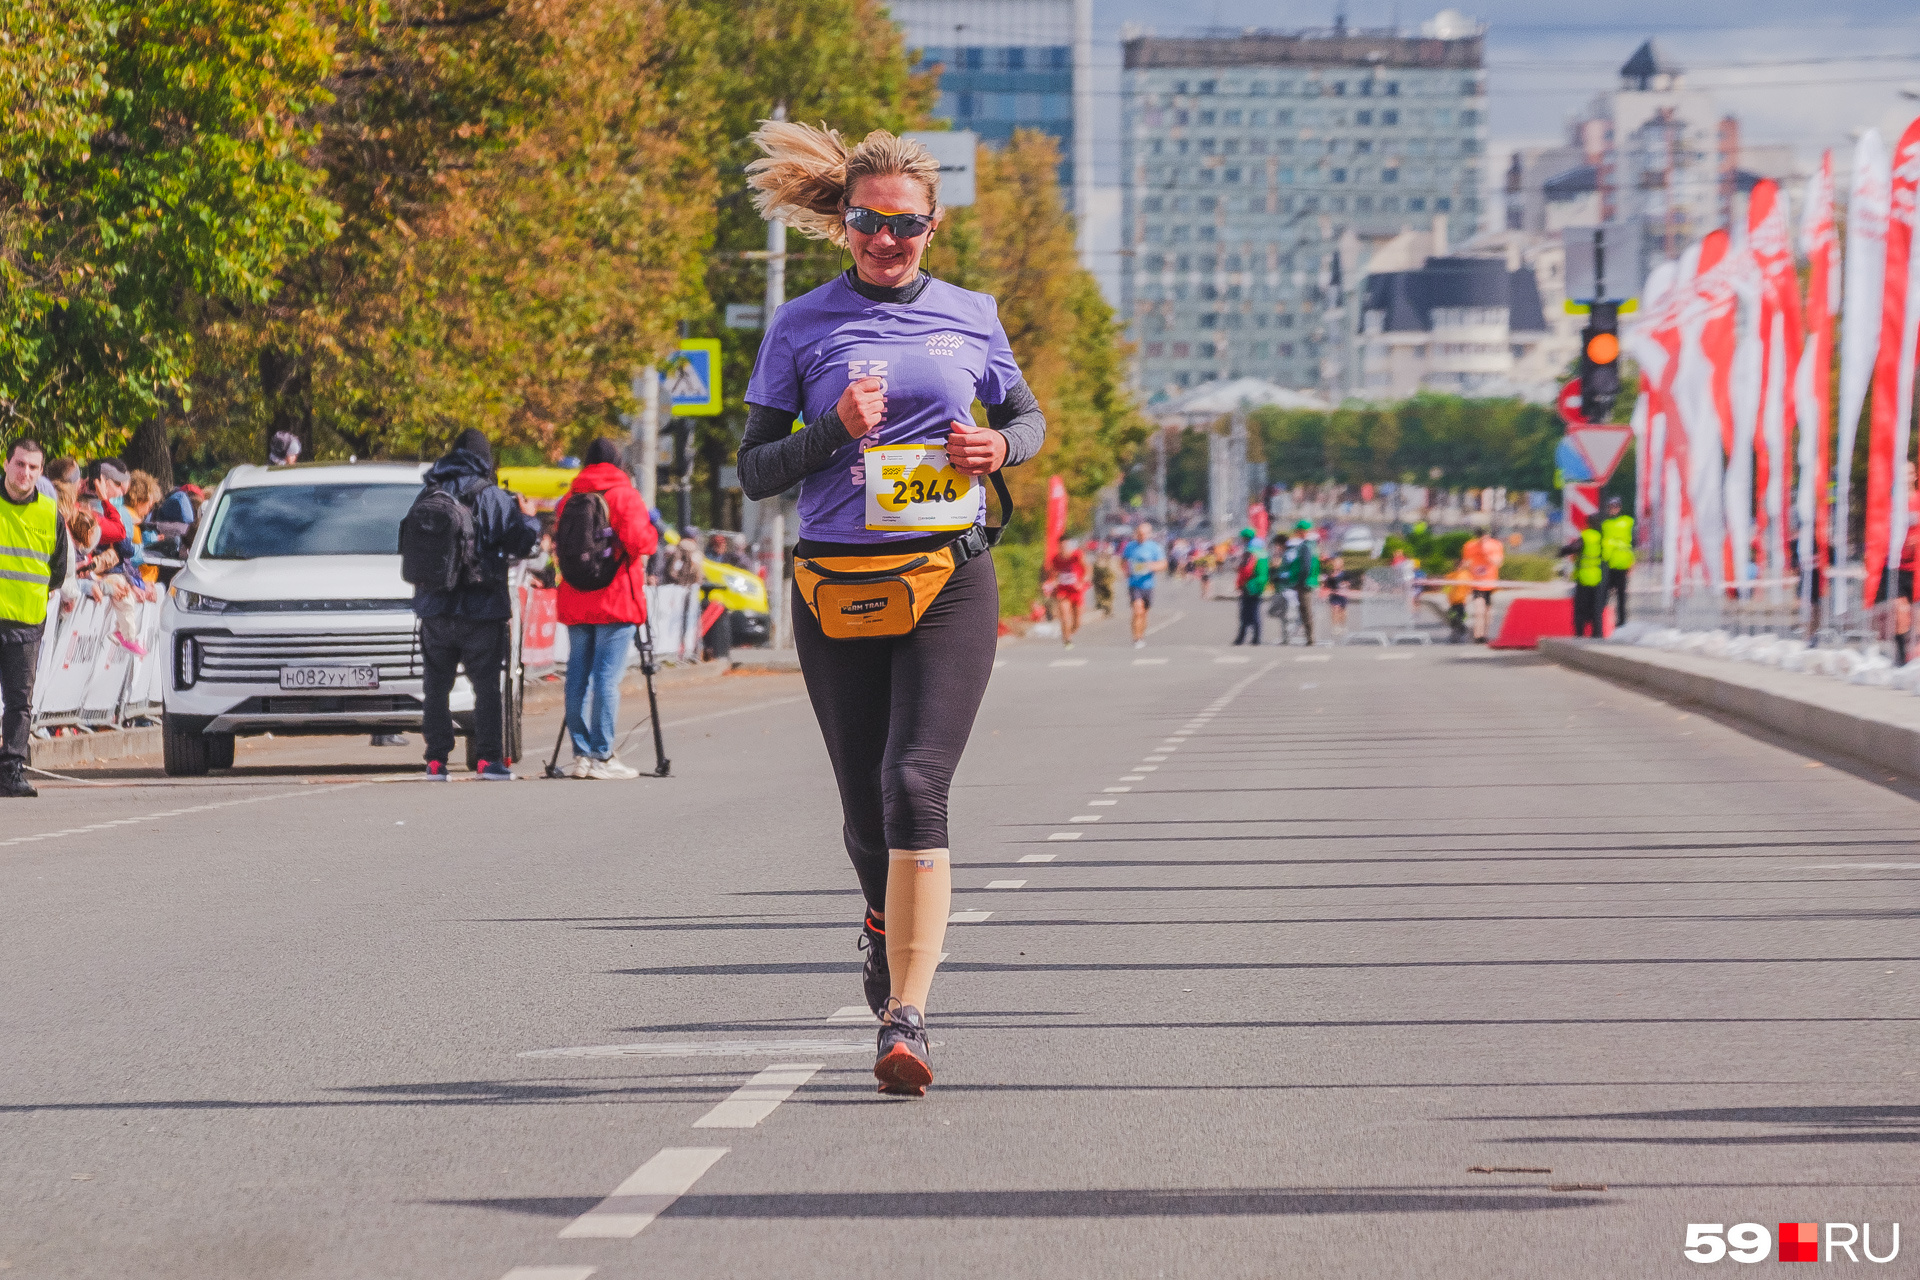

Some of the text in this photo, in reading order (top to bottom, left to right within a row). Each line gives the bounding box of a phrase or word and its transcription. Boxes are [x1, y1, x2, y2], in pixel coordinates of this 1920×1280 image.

[928, 348, 954, 357] 2022
[892, 478, 957, 504] 2346
[865, 601, 887, 610] TRAIL
[351, 668, 374, 680] 159
